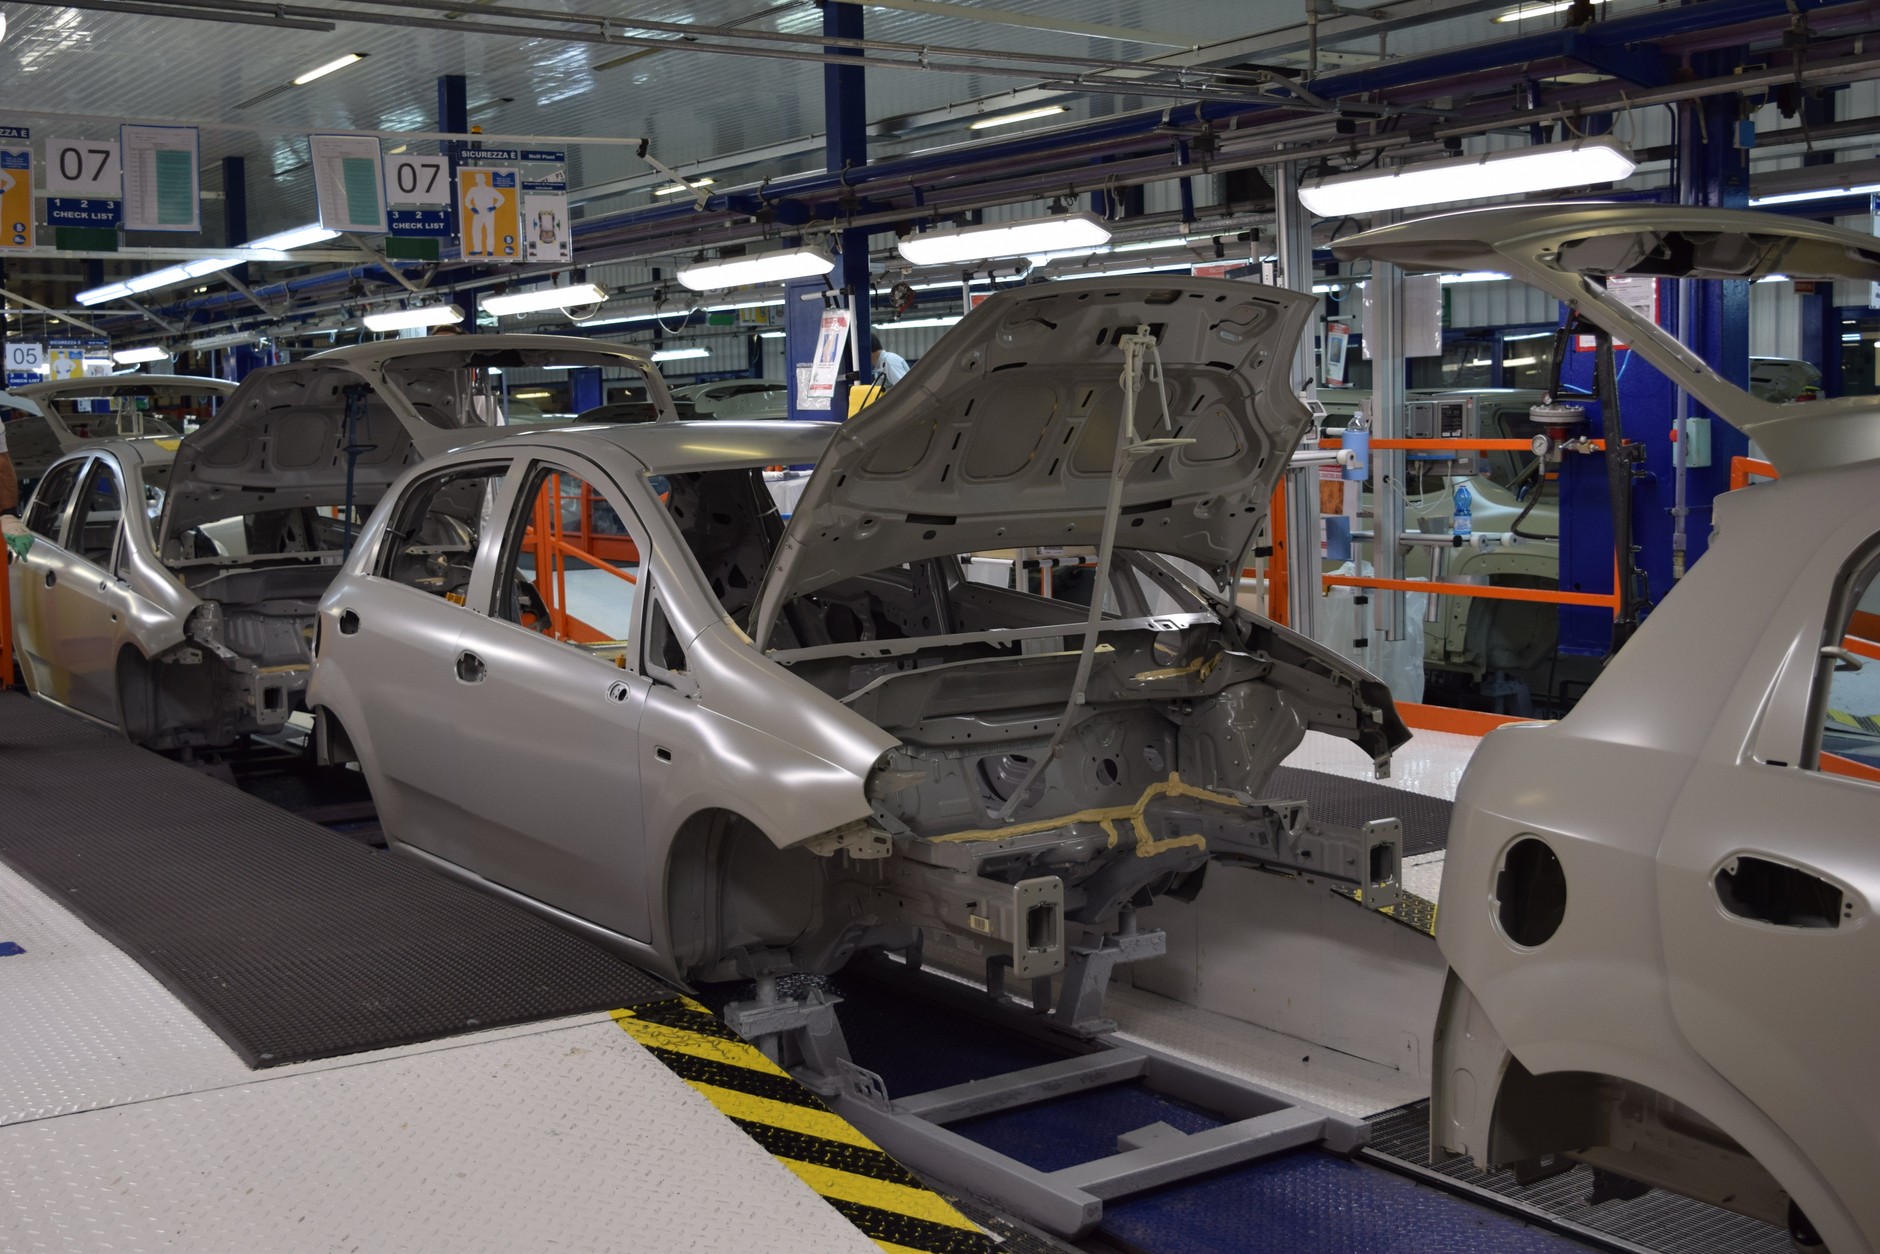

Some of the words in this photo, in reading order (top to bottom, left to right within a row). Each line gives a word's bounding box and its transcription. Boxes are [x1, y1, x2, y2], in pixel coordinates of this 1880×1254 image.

[461, 150, 509, 159] SICUREZZA
[59, 147, 111, 182] 07
[397, 163, 441, 194] 07
[54, 199, 61, 207] 1
[80, 199, 88, 208] 2
[107, 200, 114, 209] 3
[53, 211, 89, 220] CHECK
[91, 212, 114, 220] LIST
[392, 211, 399, 219] 3
[415, 211, 423, 219] 2
[439, 211, 444, 219] 1
[392, 221, 424, 230] CHECK
[425, 222, 445, 230] LIST
[13, 347, 37, 365] 05
